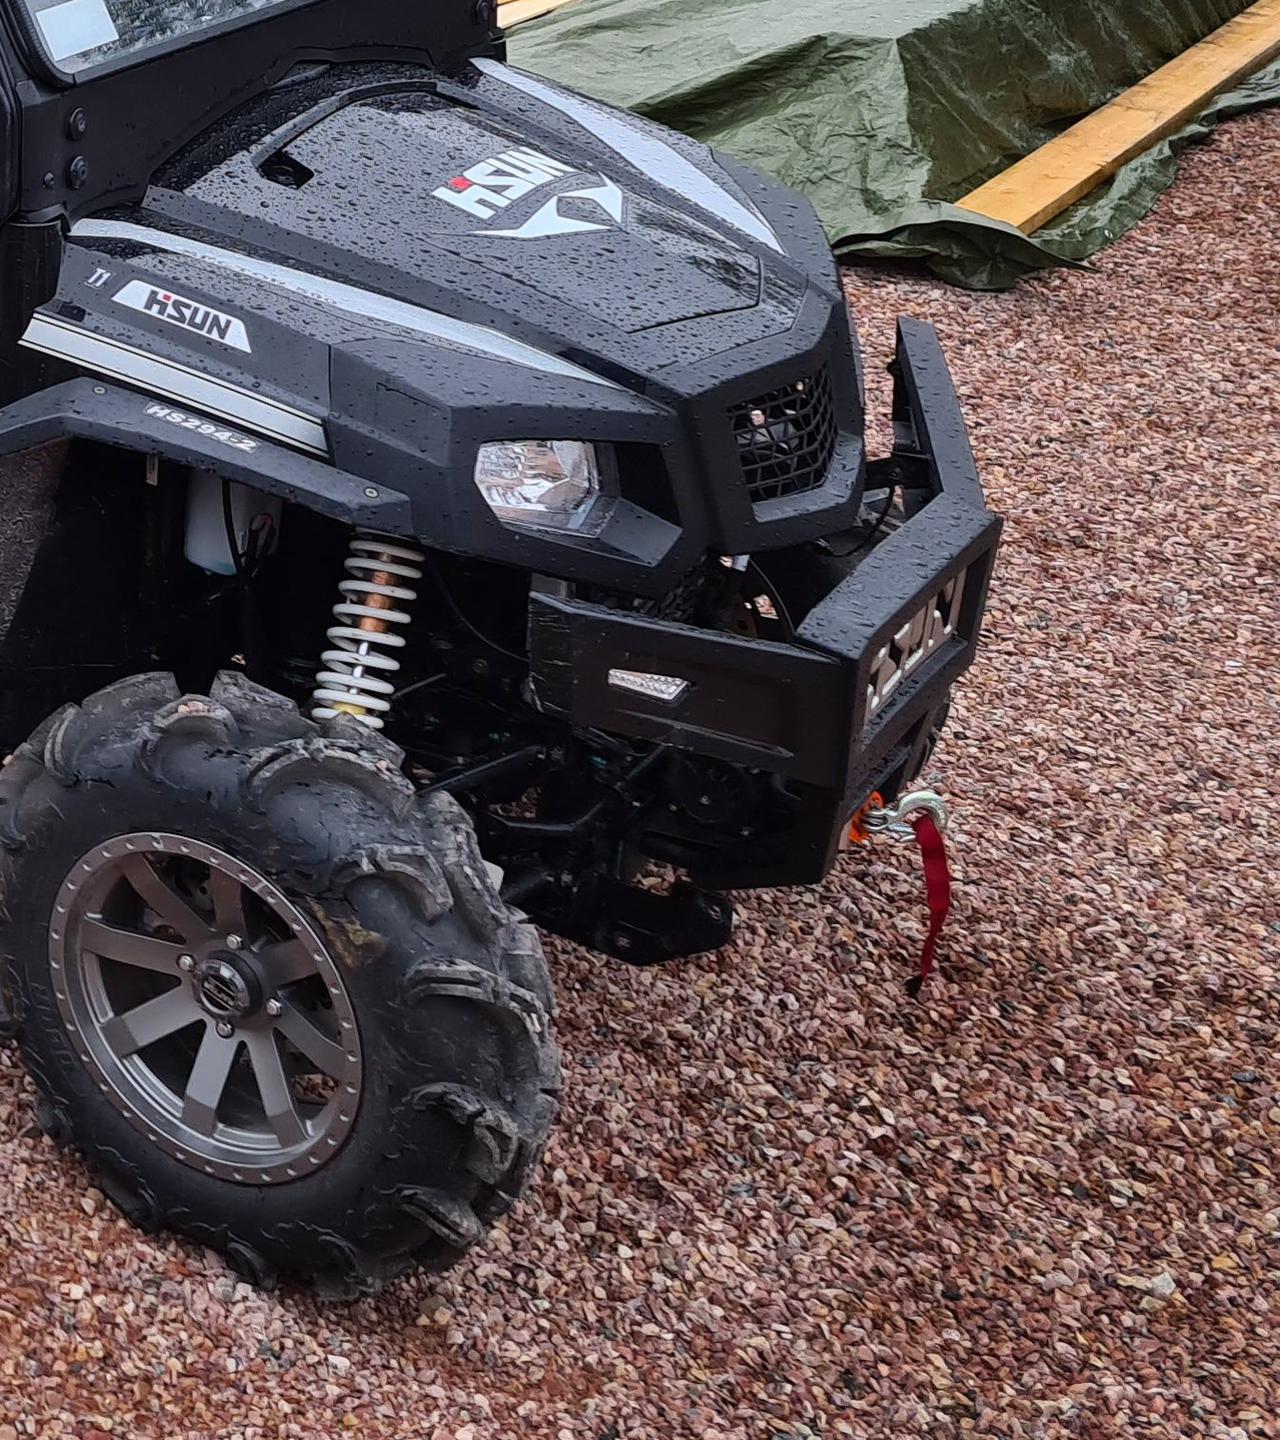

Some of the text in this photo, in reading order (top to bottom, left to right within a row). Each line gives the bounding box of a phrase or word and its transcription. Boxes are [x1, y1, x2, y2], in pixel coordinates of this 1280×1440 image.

[430, 146, 579, 220] HSUN
[143, 289, 232, 340] HSUN
[146, 405, 257, 452] HS294-2
